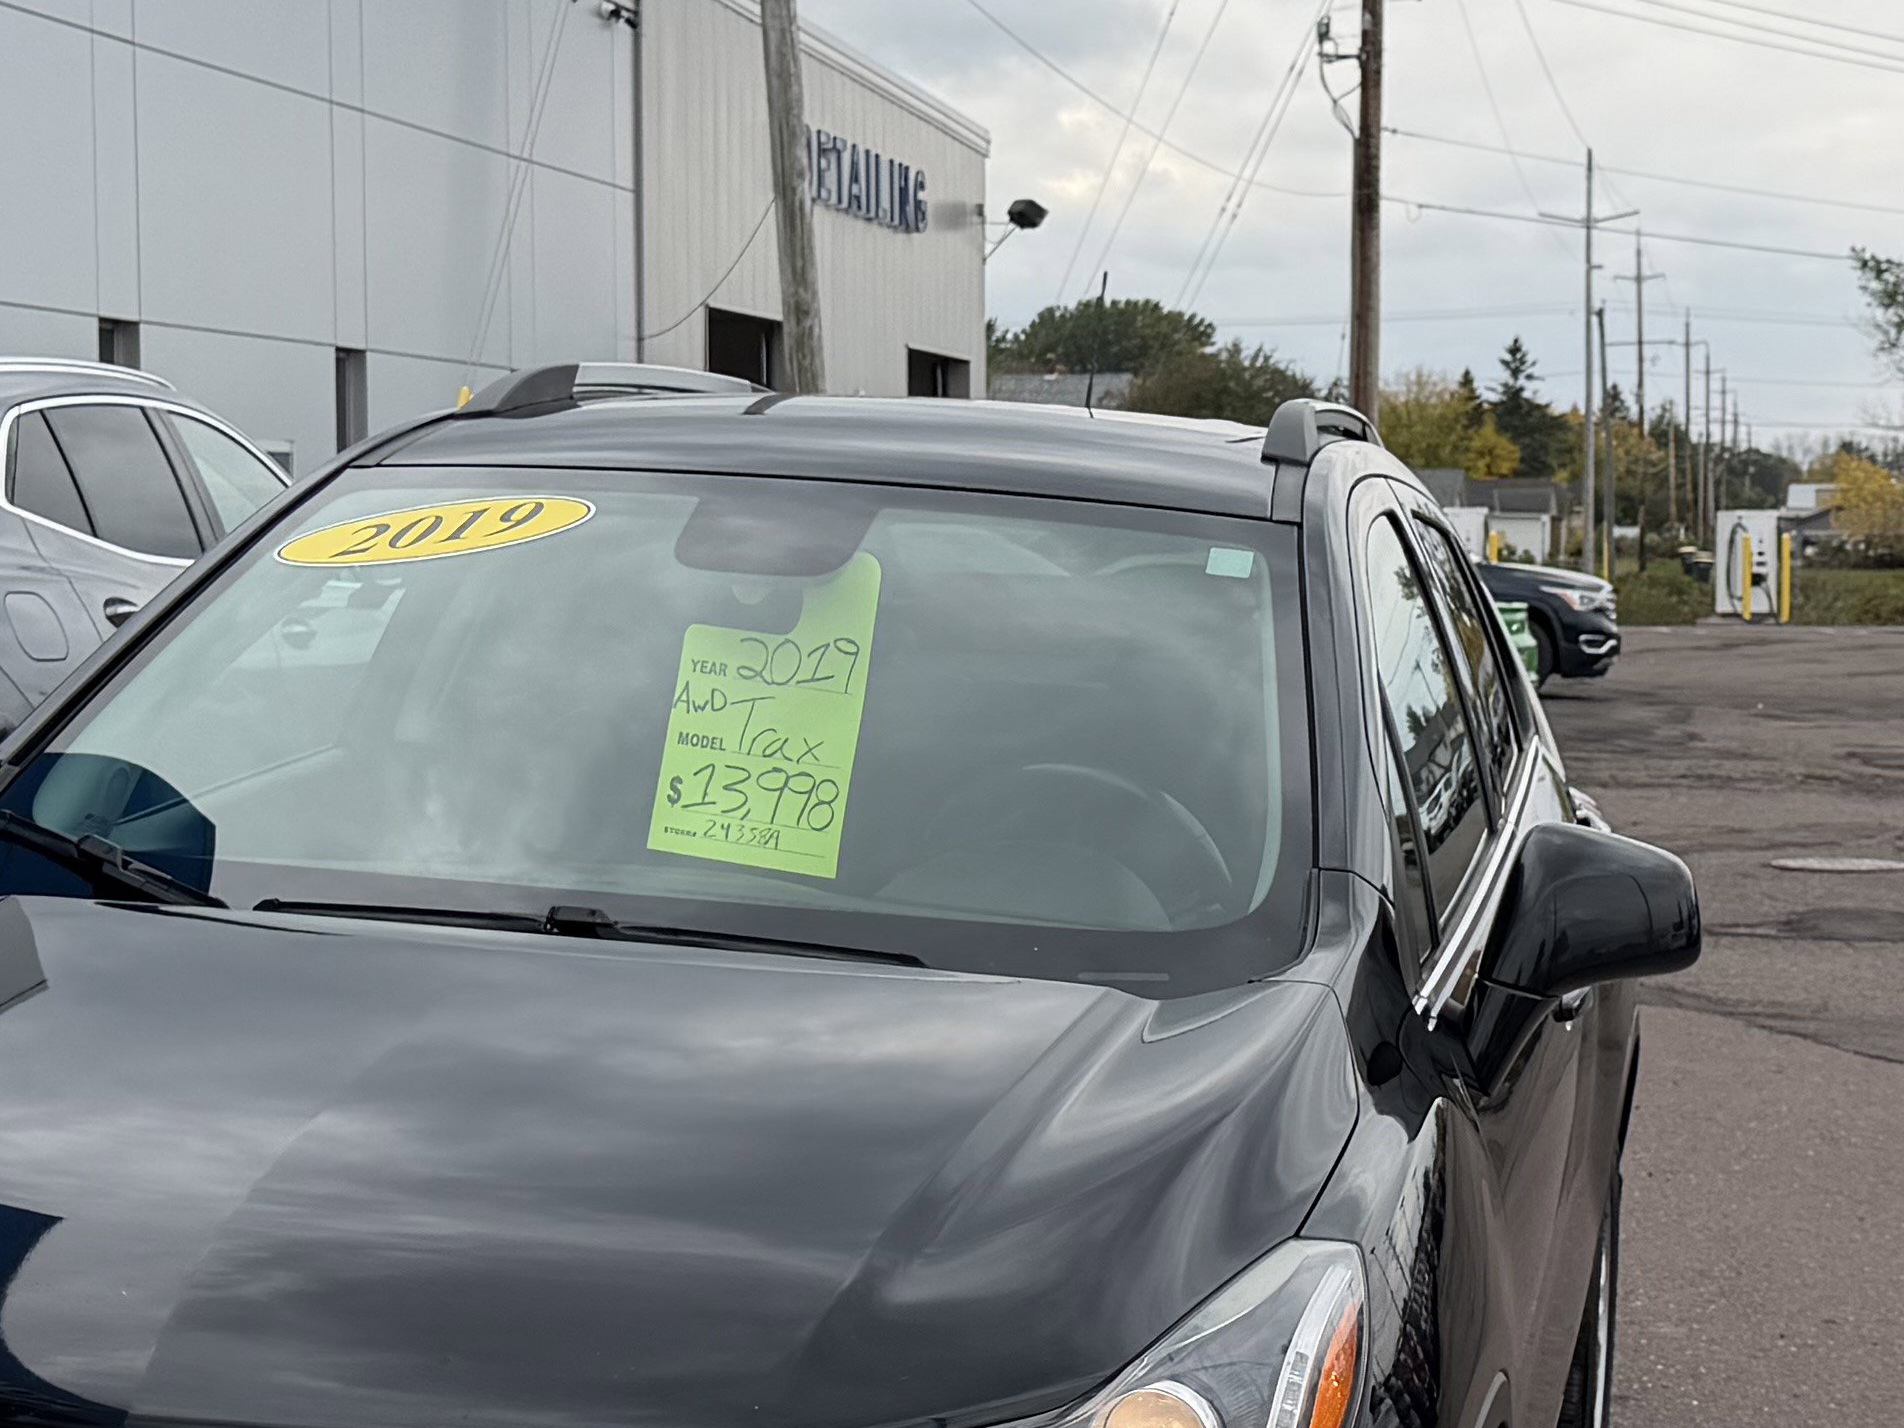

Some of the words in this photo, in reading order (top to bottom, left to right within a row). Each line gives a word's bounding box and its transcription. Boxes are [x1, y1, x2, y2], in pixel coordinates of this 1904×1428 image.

[803, 124, 927, 233] ETAILING
[329, 501, 545, 559] 2019
[691, 659, 728, 677] YEAR
[736, 637, 860, 695] 2019
[677, 731, 726, 752] MODEL
[730, 695, 825, 765] Trax
